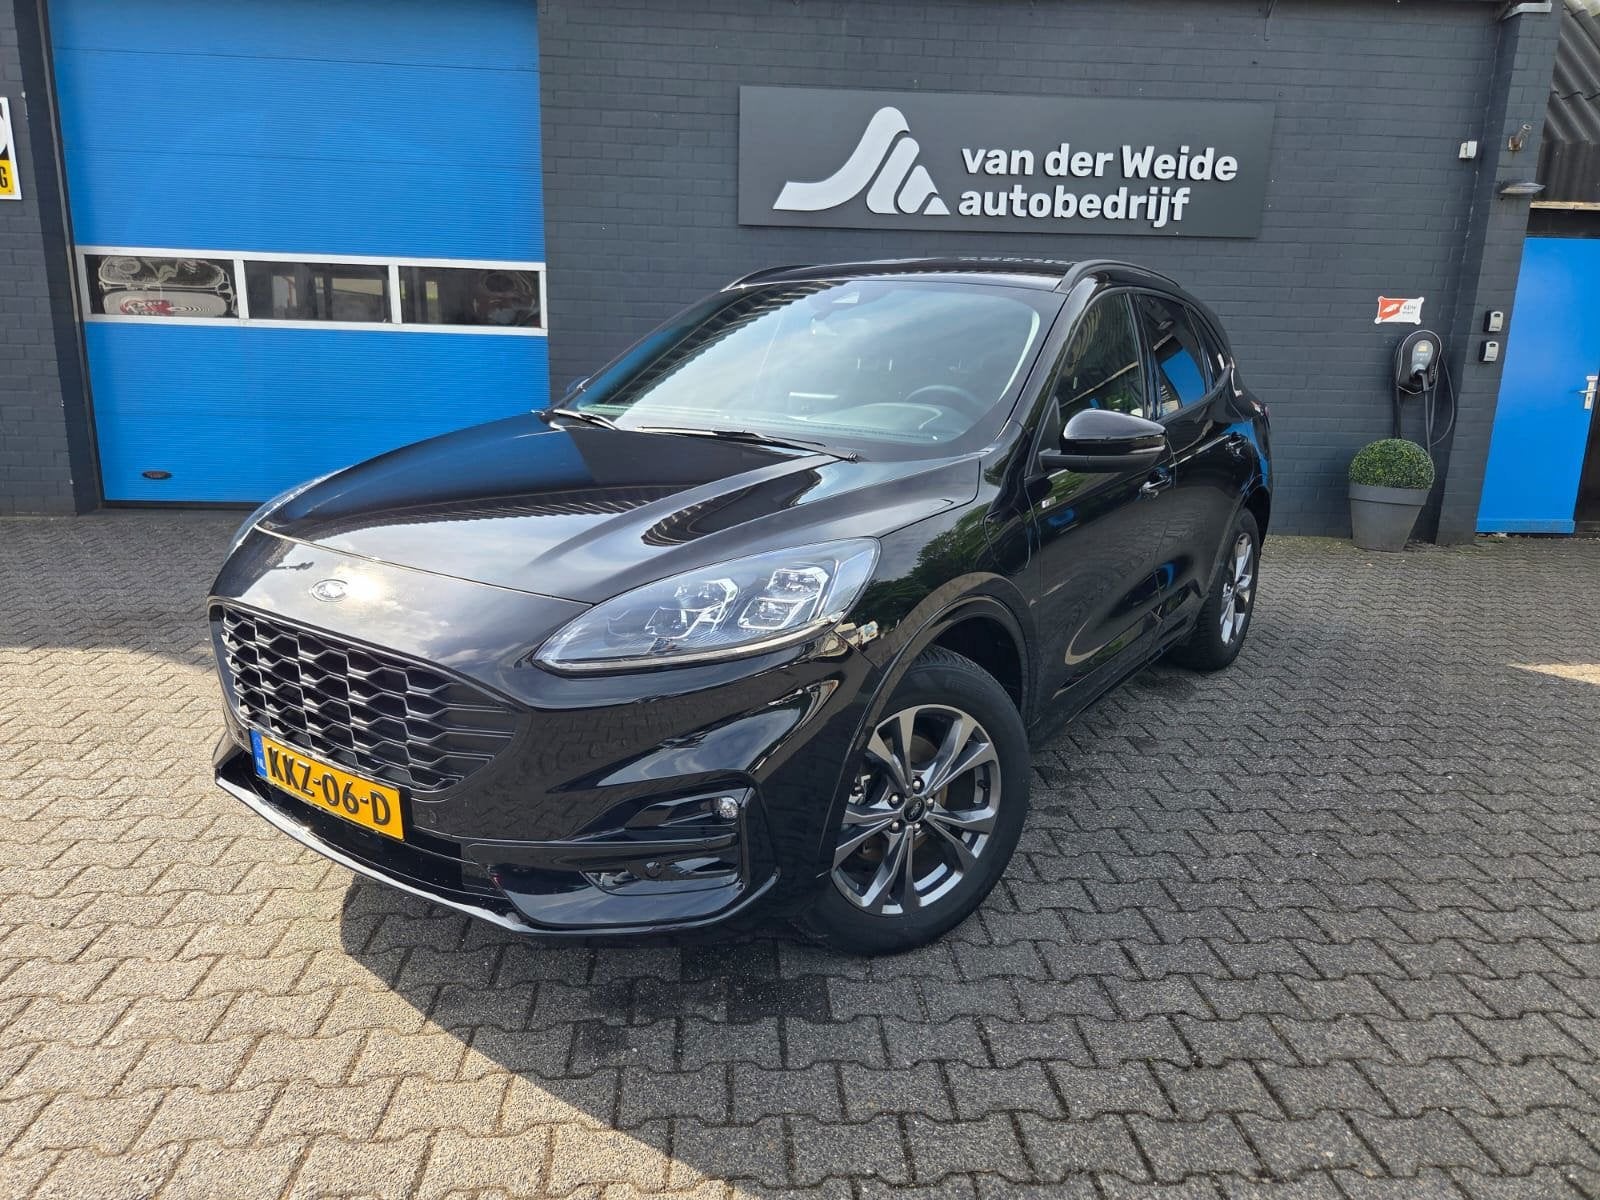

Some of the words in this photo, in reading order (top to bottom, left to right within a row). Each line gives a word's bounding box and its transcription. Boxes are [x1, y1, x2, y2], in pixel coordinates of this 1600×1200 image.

[962, 148, 1034, 175] van
[1045, 143, 1113, 177] der
[1122, 145, 1238, 181] Weide
[958, 184, 1191, 228] autobedrijf
[267, 746, 391, 826] KKZ-06-D
